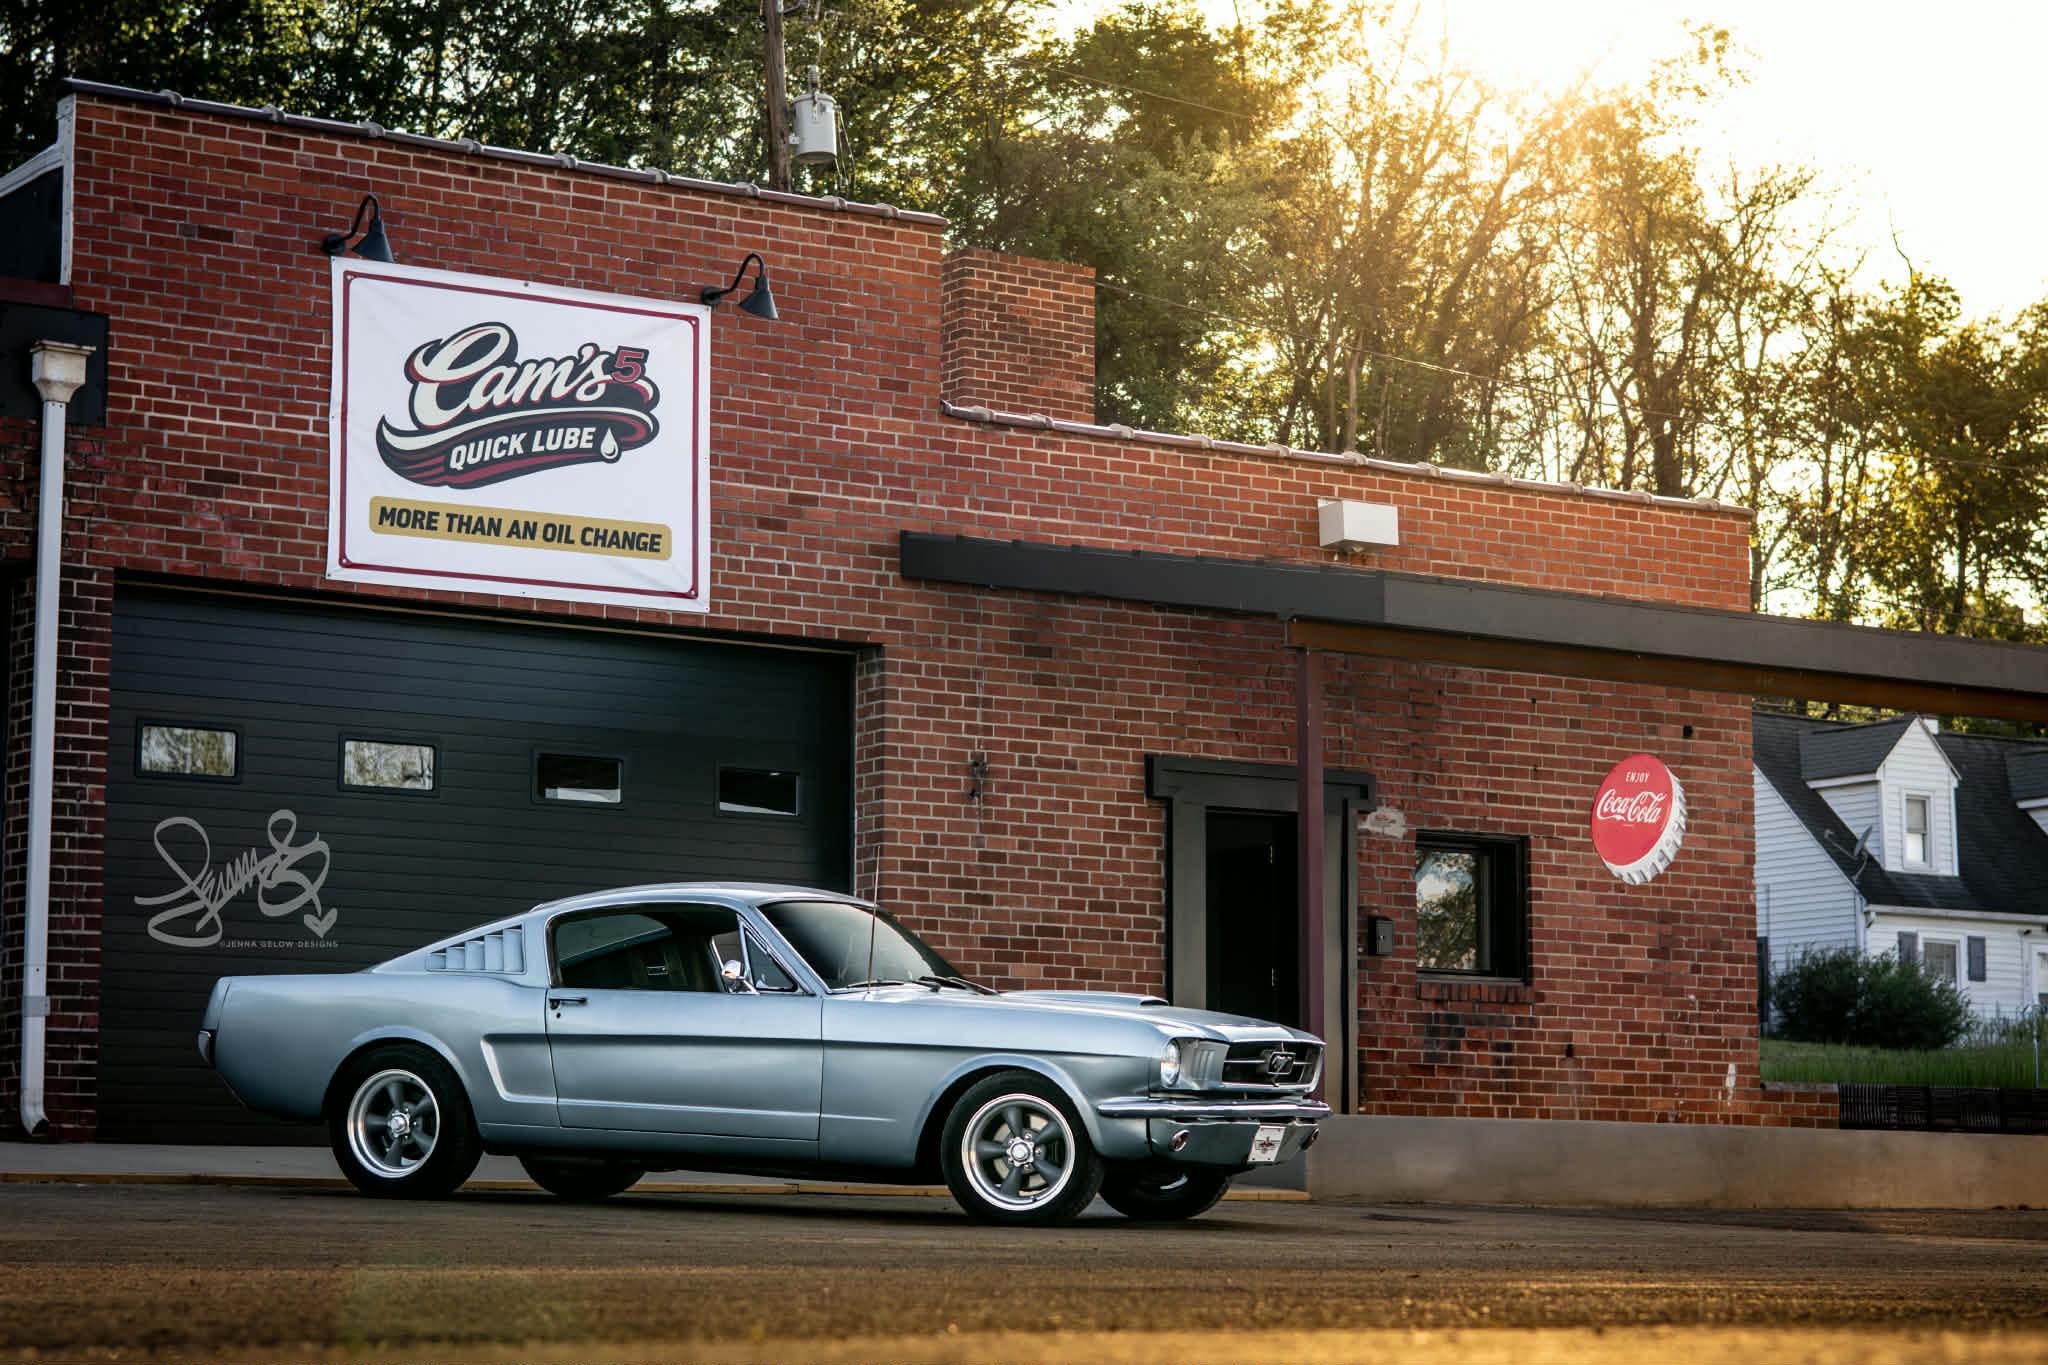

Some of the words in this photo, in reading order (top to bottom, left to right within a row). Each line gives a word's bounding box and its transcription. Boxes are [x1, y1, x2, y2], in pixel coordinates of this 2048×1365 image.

[405, 322, 612, 429] Cam's
[611, 346, 649, 383] 5
[449, 432, 527, 470] QUICK
[531, 426, 597, 452] LUBE
[378, 505, 440, 532] MORE
[446, 512, 503, 538] THAN
[506, 518, 537, 541] AN
[542, 521, 576, 546] OIL
[581, 526, 663, 553] CHANGE
[1625, 771, 1650, 783] ENJOY
[1596, 788, 1668, 824] Coca-Cola
